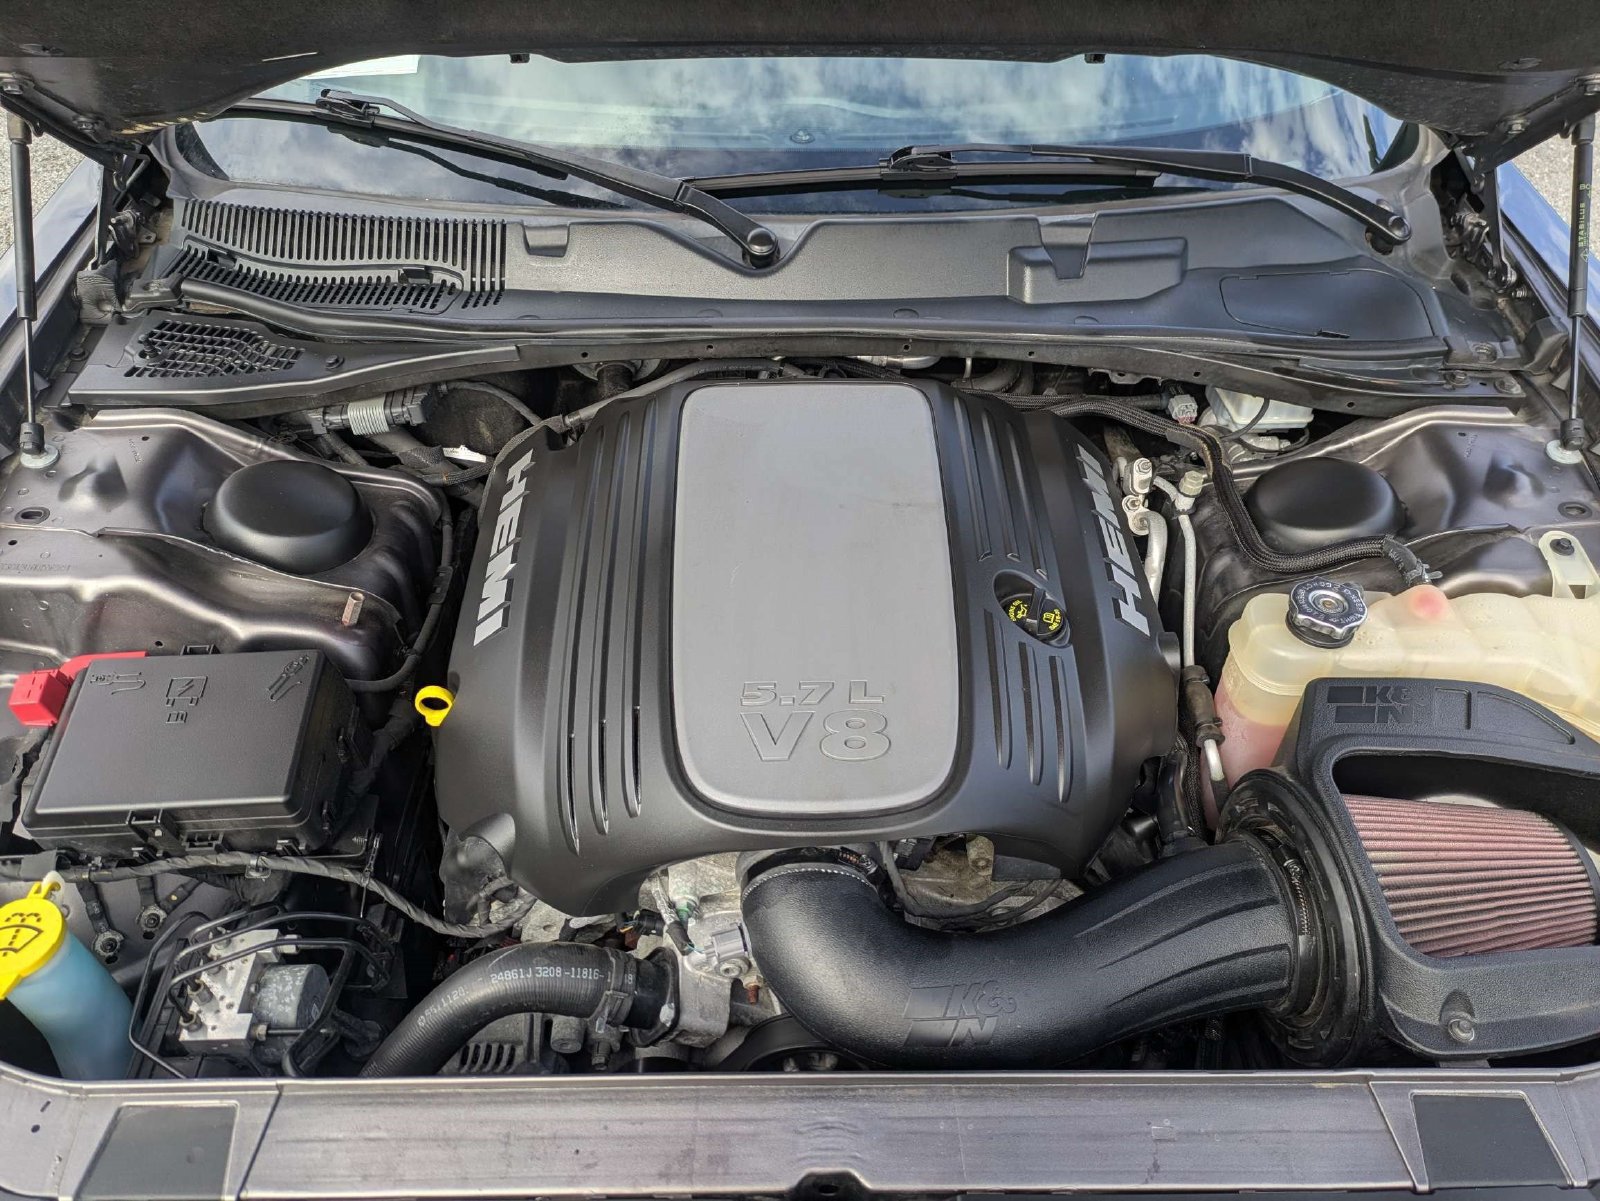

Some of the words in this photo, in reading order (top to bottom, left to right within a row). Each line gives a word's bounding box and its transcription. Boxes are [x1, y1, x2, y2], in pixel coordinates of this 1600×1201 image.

[1578, 202, 1586, 247] STABILUS
[473, 448, 534, 647] HEMI
[1077, 442, 1151, 638] HEMI
[740, 681, 835, 706] 5.7
[848, 680, 886, 705] L
[740, 708, 892, 763] V8
